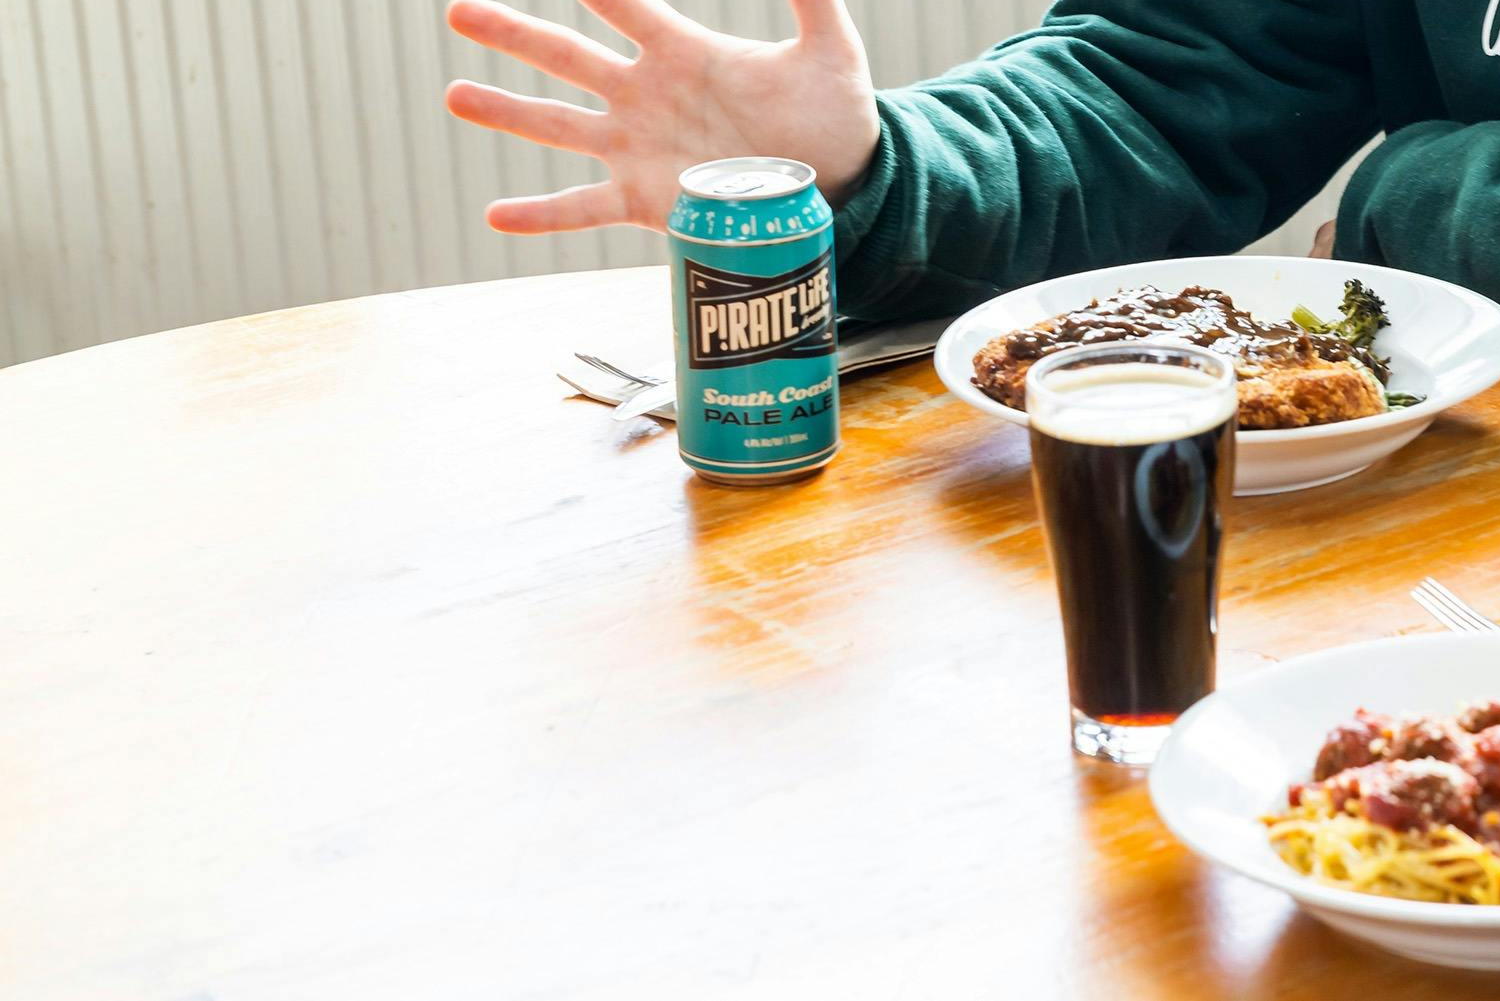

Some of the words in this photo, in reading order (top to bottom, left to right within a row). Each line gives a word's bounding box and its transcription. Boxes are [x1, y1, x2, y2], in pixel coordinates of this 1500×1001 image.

[703, 387, 777, 407] South
[778, 375, 833, 404] Coast
[704, 408, 782, 426] PALE
[790, 393, 833, 421] ALE
